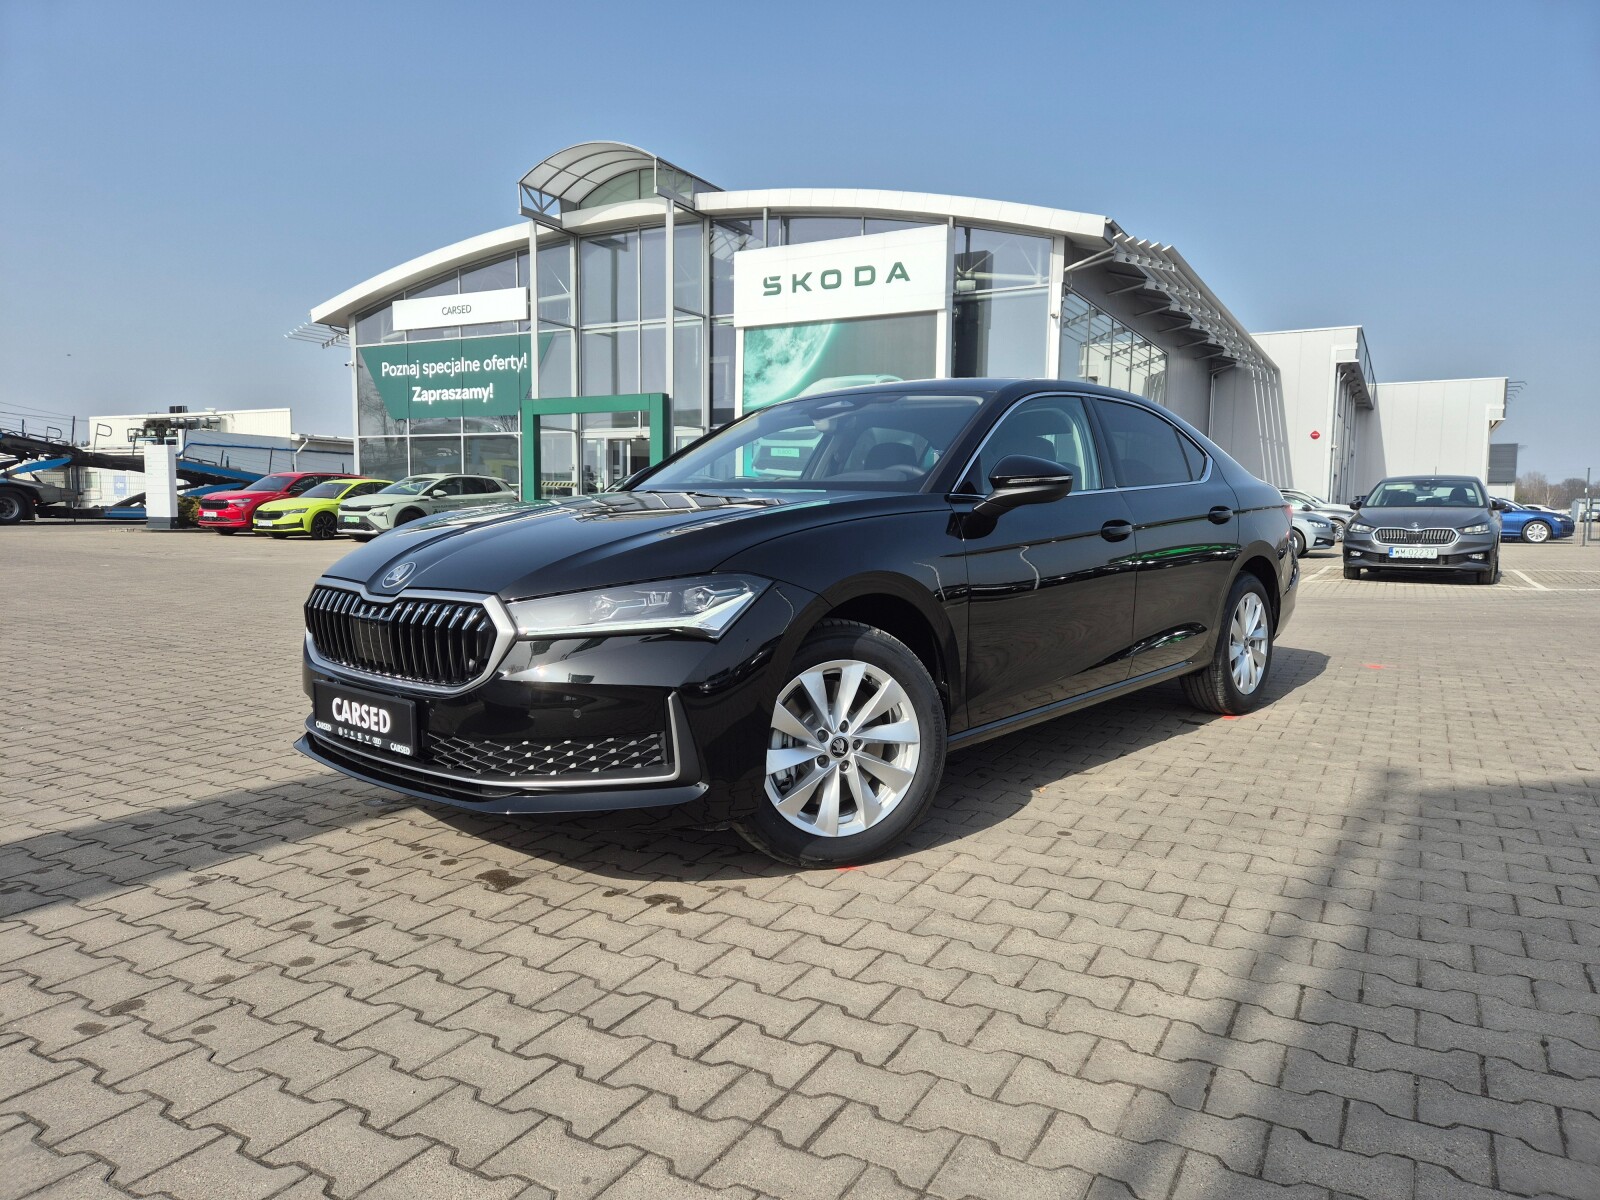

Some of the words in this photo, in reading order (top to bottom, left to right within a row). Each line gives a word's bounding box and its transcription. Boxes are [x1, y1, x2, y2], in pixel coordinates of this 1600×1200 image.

[441, 304, 472, 316] CARSED
[381, 360, 420, 379] Poznaj
[422, 356, 480, 378] specjalne
[483, 352, 528, 374] oferty!
[411, 382, 494, 404] Zapraszamy!
[332, 697, 391, 734] CARSED
[390, 742, 410, 756] CARSED
